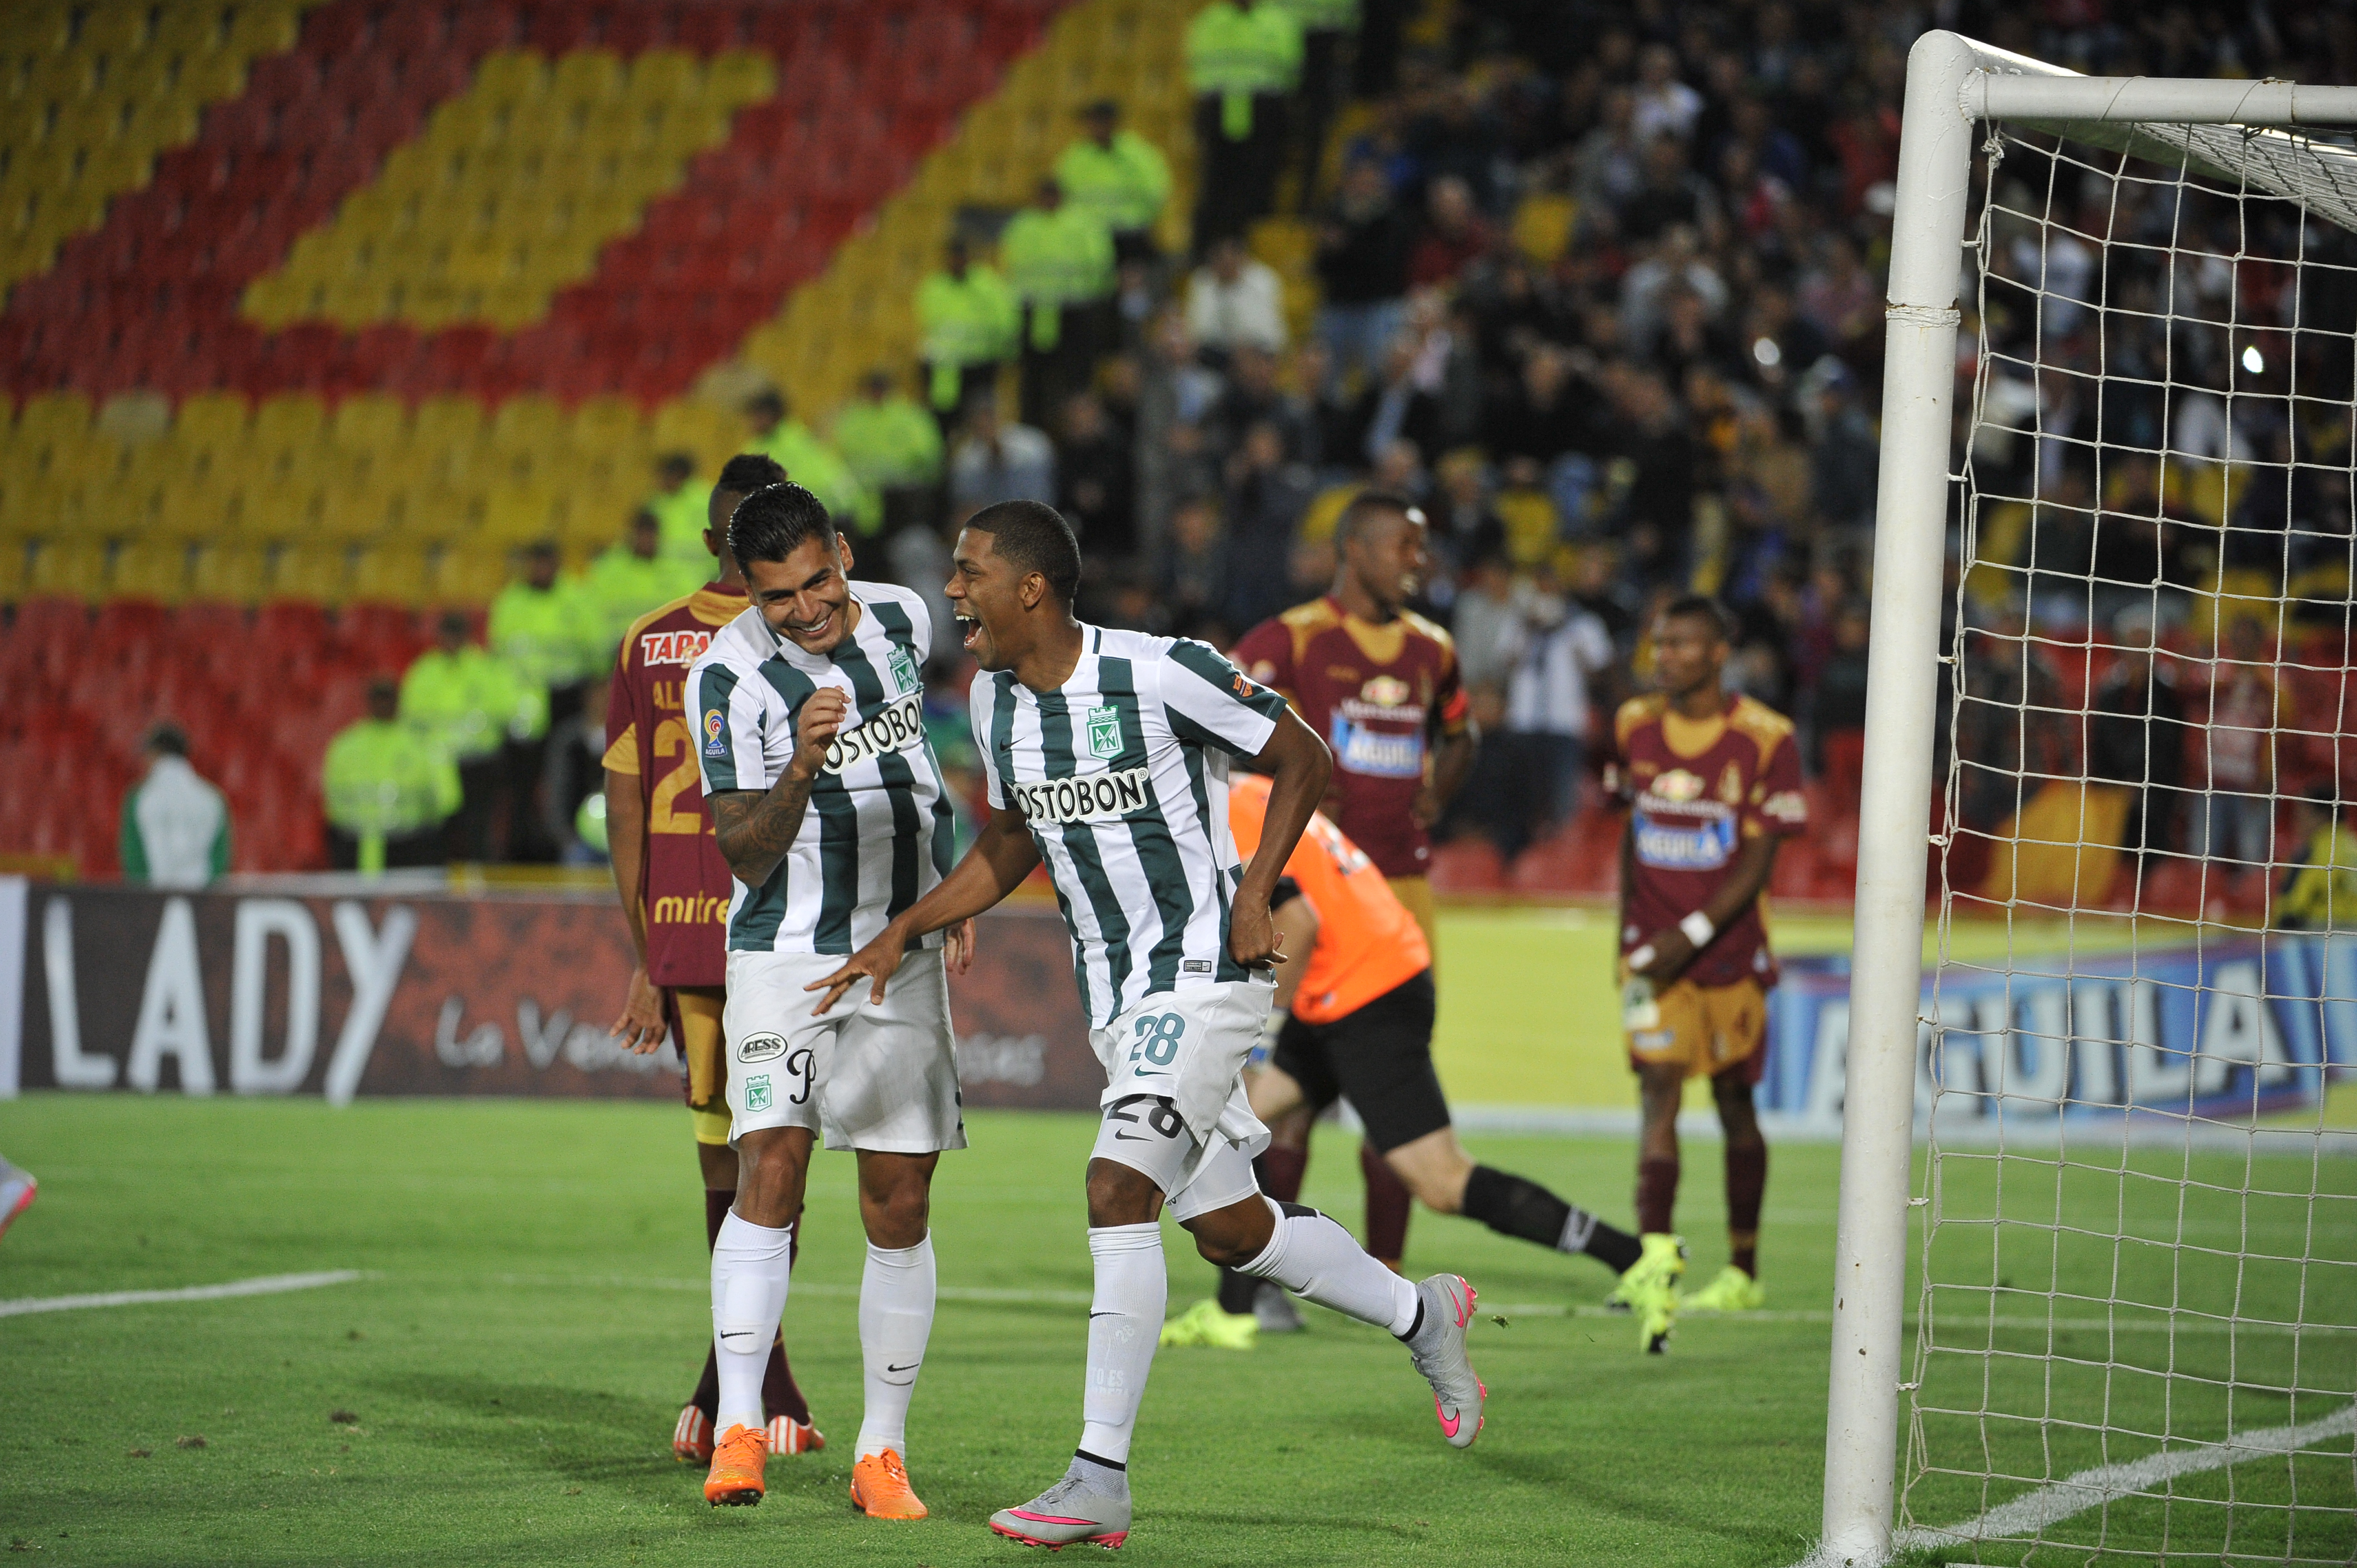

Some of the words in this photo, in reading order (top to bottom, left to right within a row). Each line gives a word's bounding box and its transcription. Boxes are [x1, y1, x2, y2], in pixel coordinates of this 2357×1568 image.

[822, 697, 922, 770] OSTOBO
[651, 716, 716, 835] 2
[654, 889, 729, 925] mitre
[44, 895, 419, 1106] LADY
[435, 995, 503, 1069] La
[740, 1038, 781, 1058] ARESS
[1129, 1012, 1186, 1066] 28
